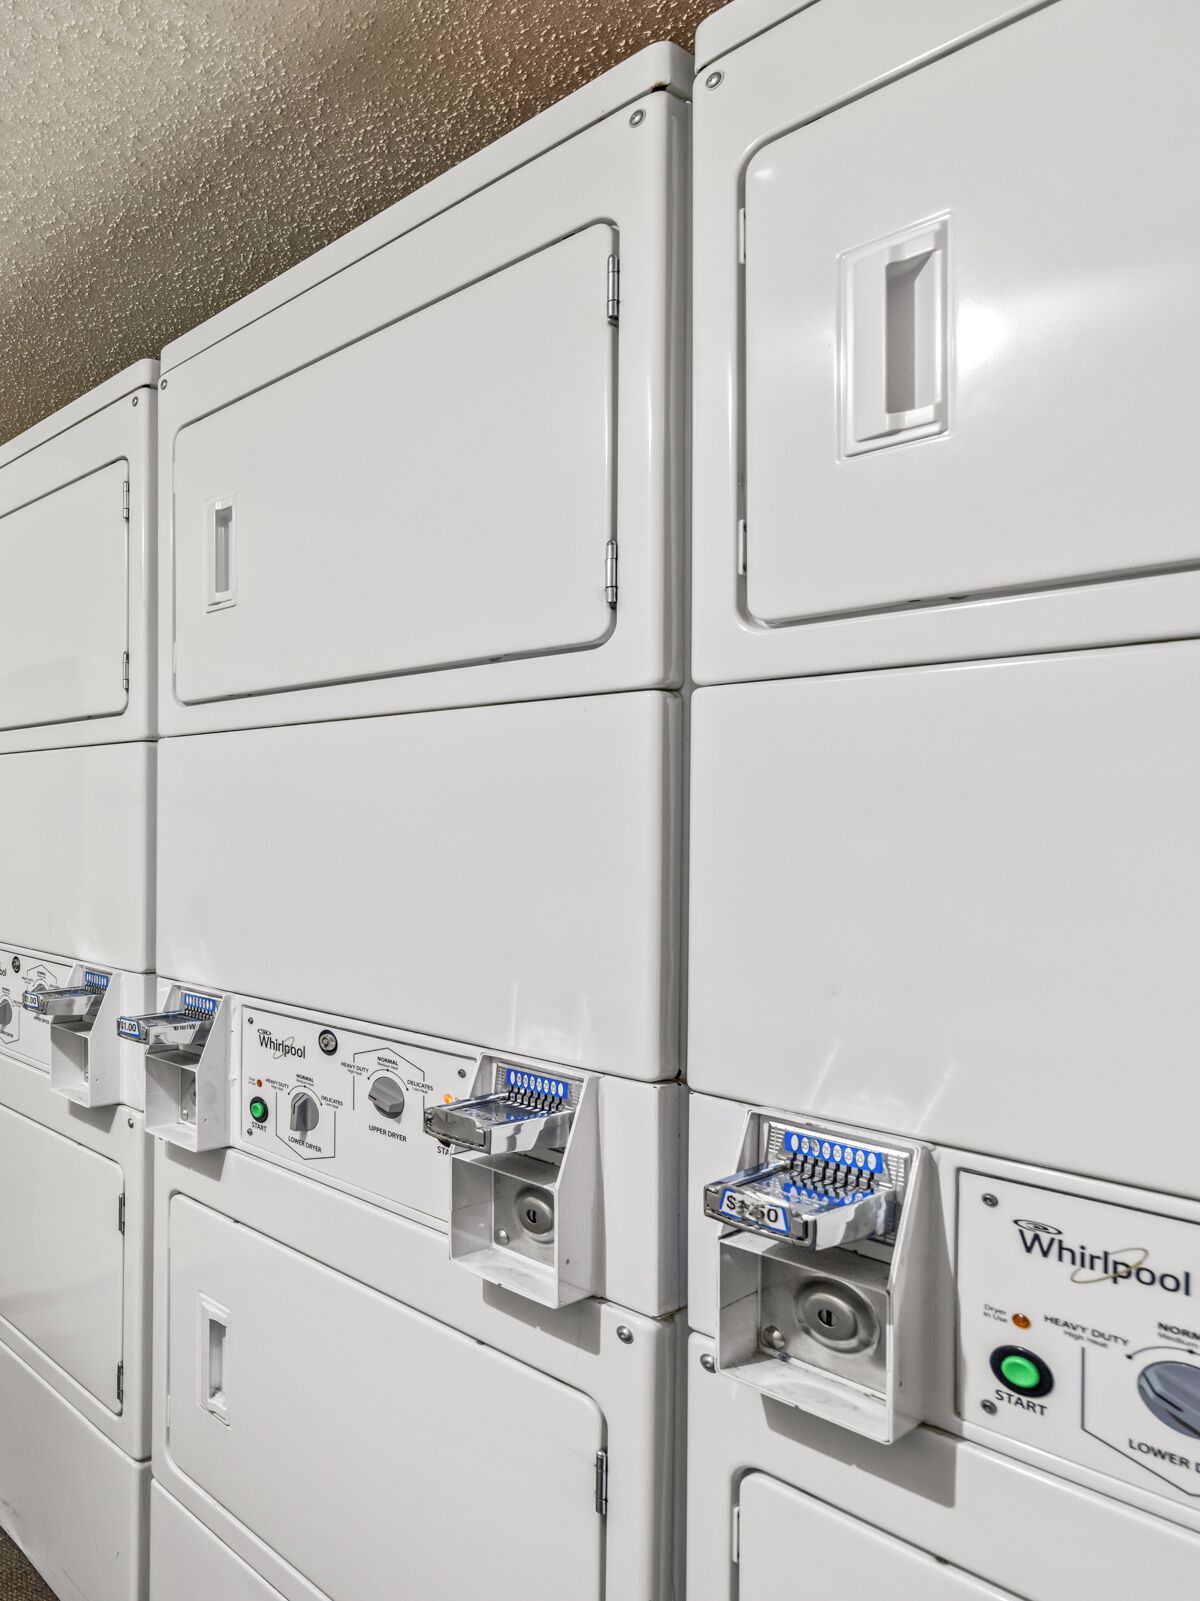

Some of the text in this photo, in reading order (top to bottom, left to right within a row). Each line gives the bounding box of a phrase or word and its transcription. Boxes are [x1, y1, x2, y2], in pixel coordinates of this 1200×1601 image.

[120, 1020, 137, 1032] $1.00
[258, 1033, 306, 1059] Whirlpool
[340, 1061, 369, 1073] HEAVY DUTY
[377, 1056, 399, 1066] NORMAL
[265, 1078, 278, 1086] HEAVY
[278, 1081, 289, 1089] DUTY
[296, 1073, 314, 1083] NORMAL
[407, 1079, 434, 1092] DELICATES
[320, 1095, 344, 1107] DELICATES
[251, 1121, 267, 1133] START
[368, 1124, 407, 1142] UPPER DRYER
[288, 1135, 322, 1153] LOWER DRYER
[437, 1145, 450, 1156] STA
[1018, 1229, 1192, 1297] Whirlpool
[984, 1303, 1007, 1315] Dryer
[993, 1313, 1008, 1323] Use
[1044, 1315, 1129, 1346] HEAVY DUTY
[1063, 1329, 1086, 1341] High
[1157, 1332, 1199, 1348] Medium
[995, 1389, 1048, 1417] START
[1128, 1438, 1190, 1470] LOWER
